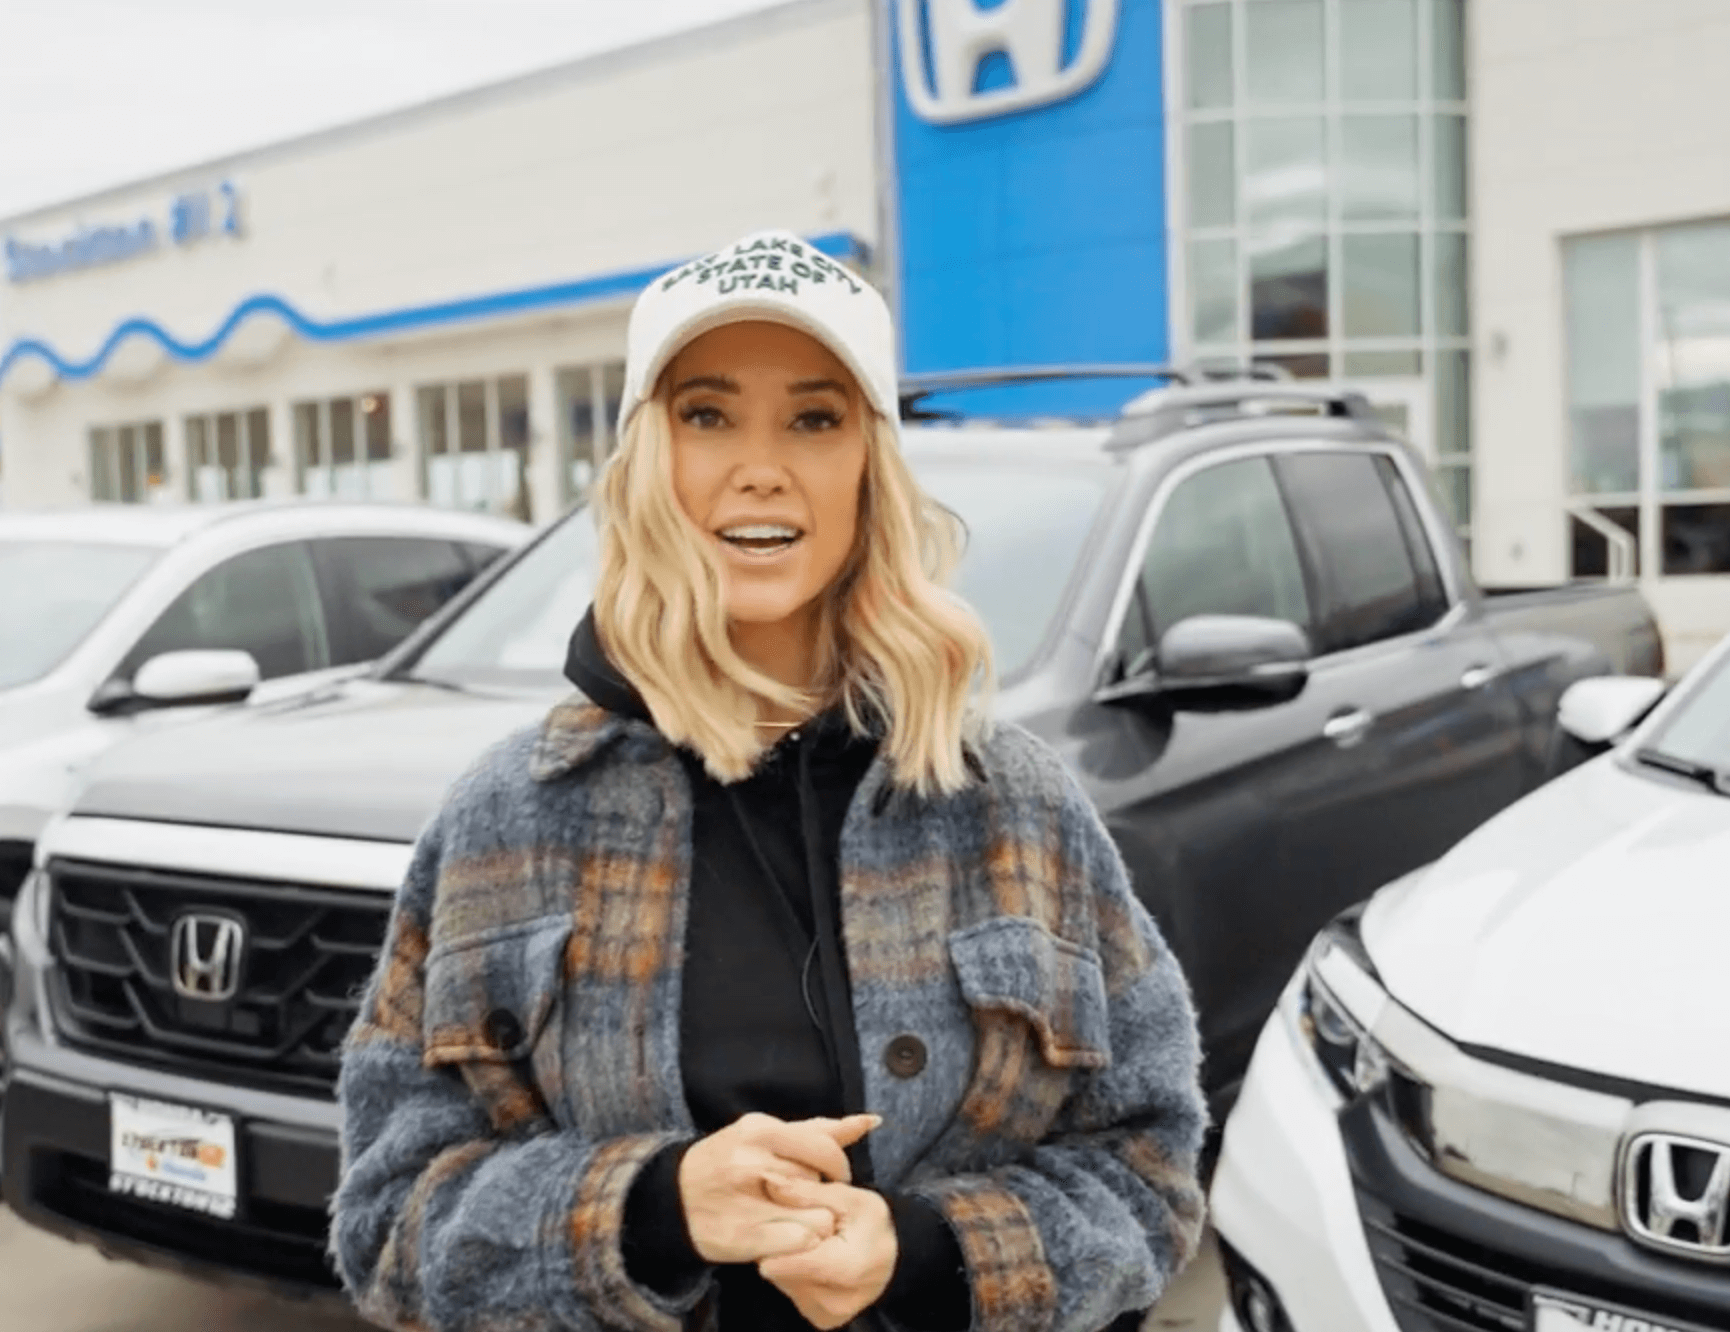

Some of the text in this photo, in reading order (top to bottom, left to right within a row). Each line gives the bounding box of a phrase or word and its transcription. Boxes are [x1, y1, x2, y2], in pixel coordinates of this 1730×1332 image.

[697, 254, 826, 284] STATE OF
[734, 238, 803, 259] LAKE
[811, 255, 862, 294] CITY
[718, 273, 798, 296] UTAH
